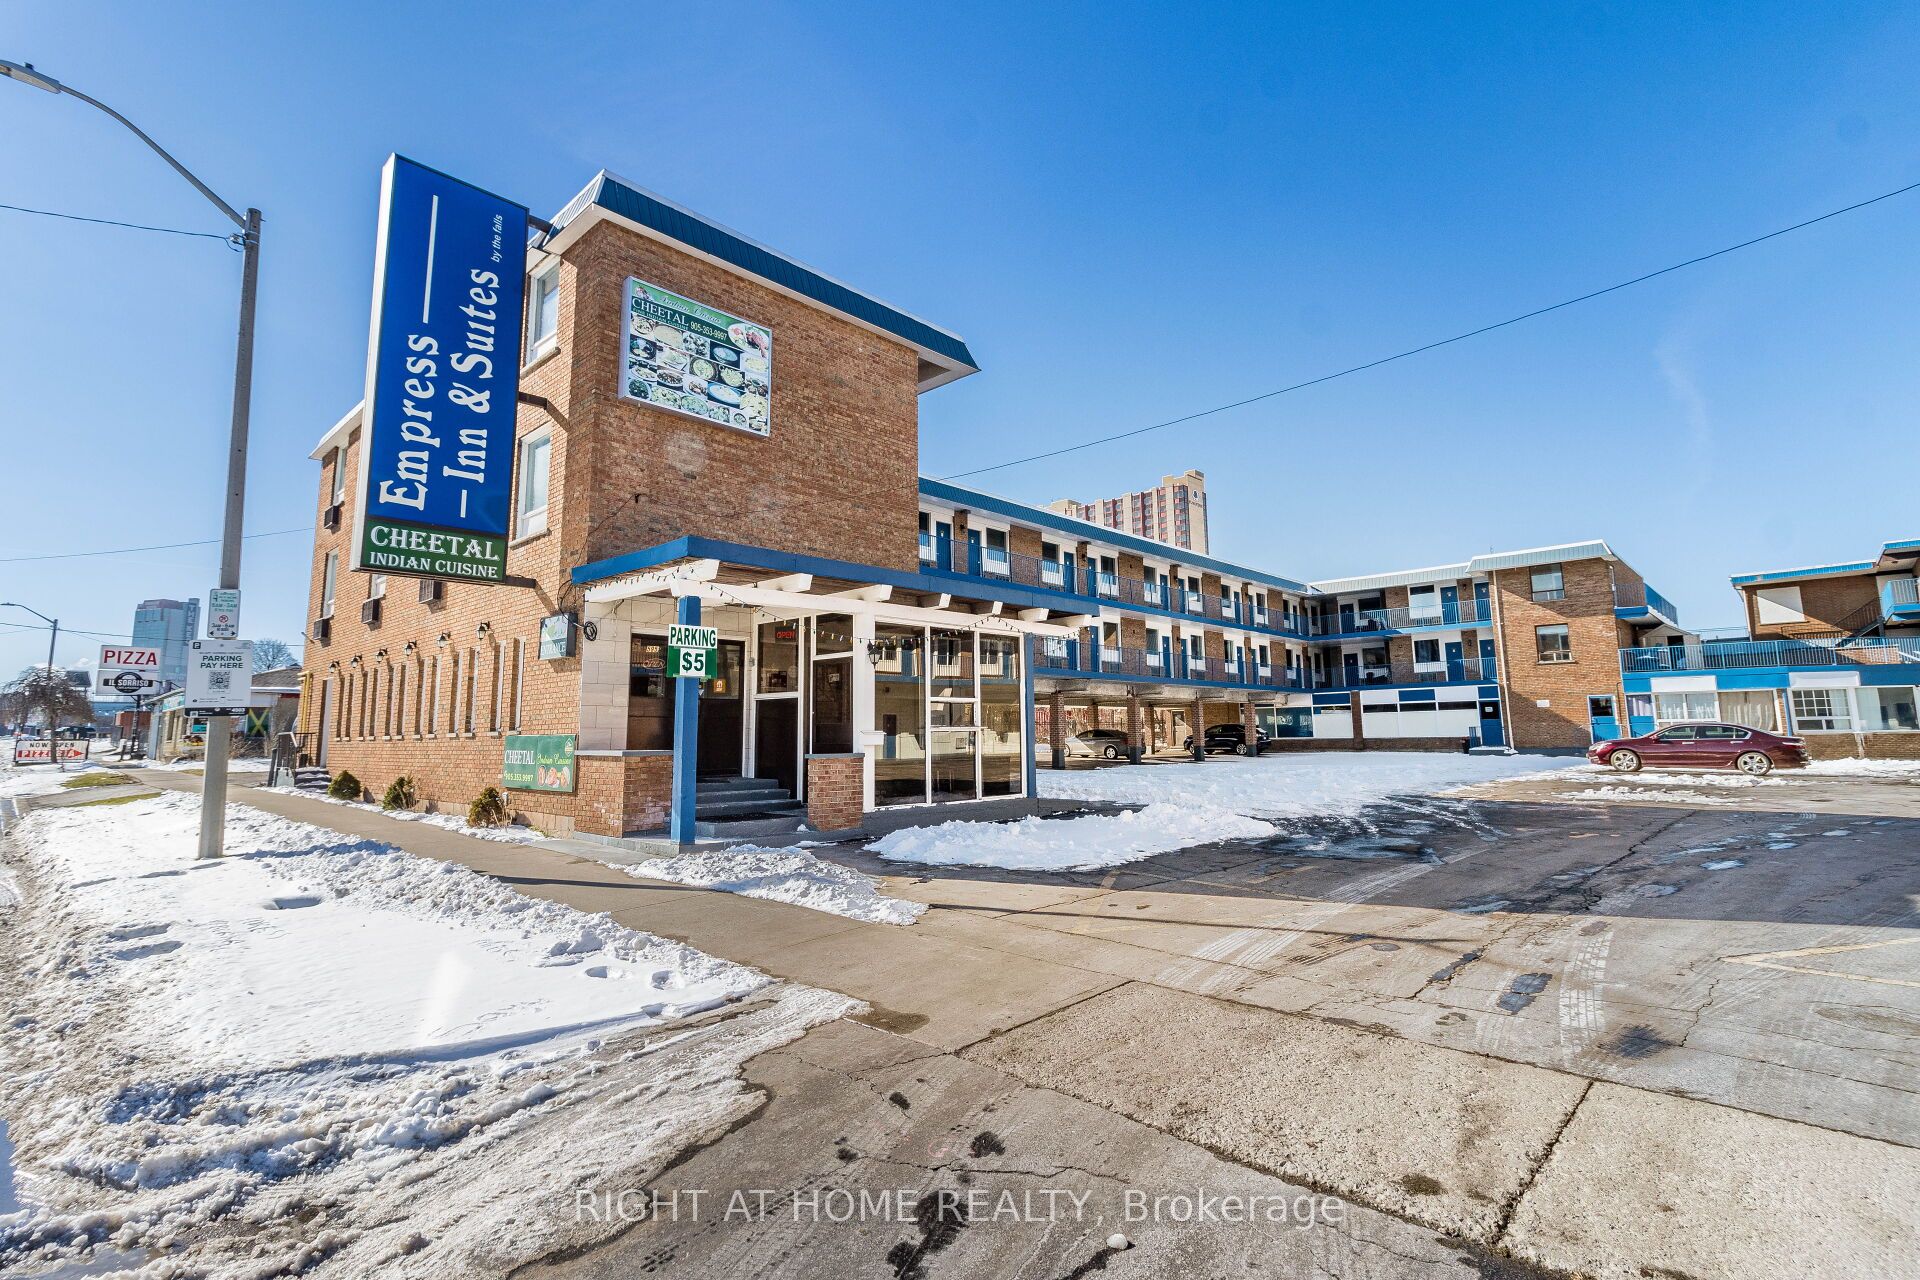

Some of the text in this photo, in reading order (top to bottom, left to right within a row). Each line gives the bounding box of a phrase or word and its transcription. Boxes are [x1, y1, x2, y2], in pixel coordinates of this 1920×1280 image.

[490, 214, 503, 263] by the falls
[632, 297, 689, 327] CHEETAL
[442, 269, 500, 484] Inn & Suites
[379, 334, 441, 511] Empress
[370, 525, 500, 561] CHEETAL
[369, 551, 498, 578] INDIAN CUISINE
[670, 626, 716, 647] PARKING
[776, 631, 796, 639] OPEN
[103, 649, 157, 666] PIZZA
[681, 651, 704, 673] $5
[117, 679, 149, 687] SORRISO
[504, 749, 536, 765] CHEETAL
